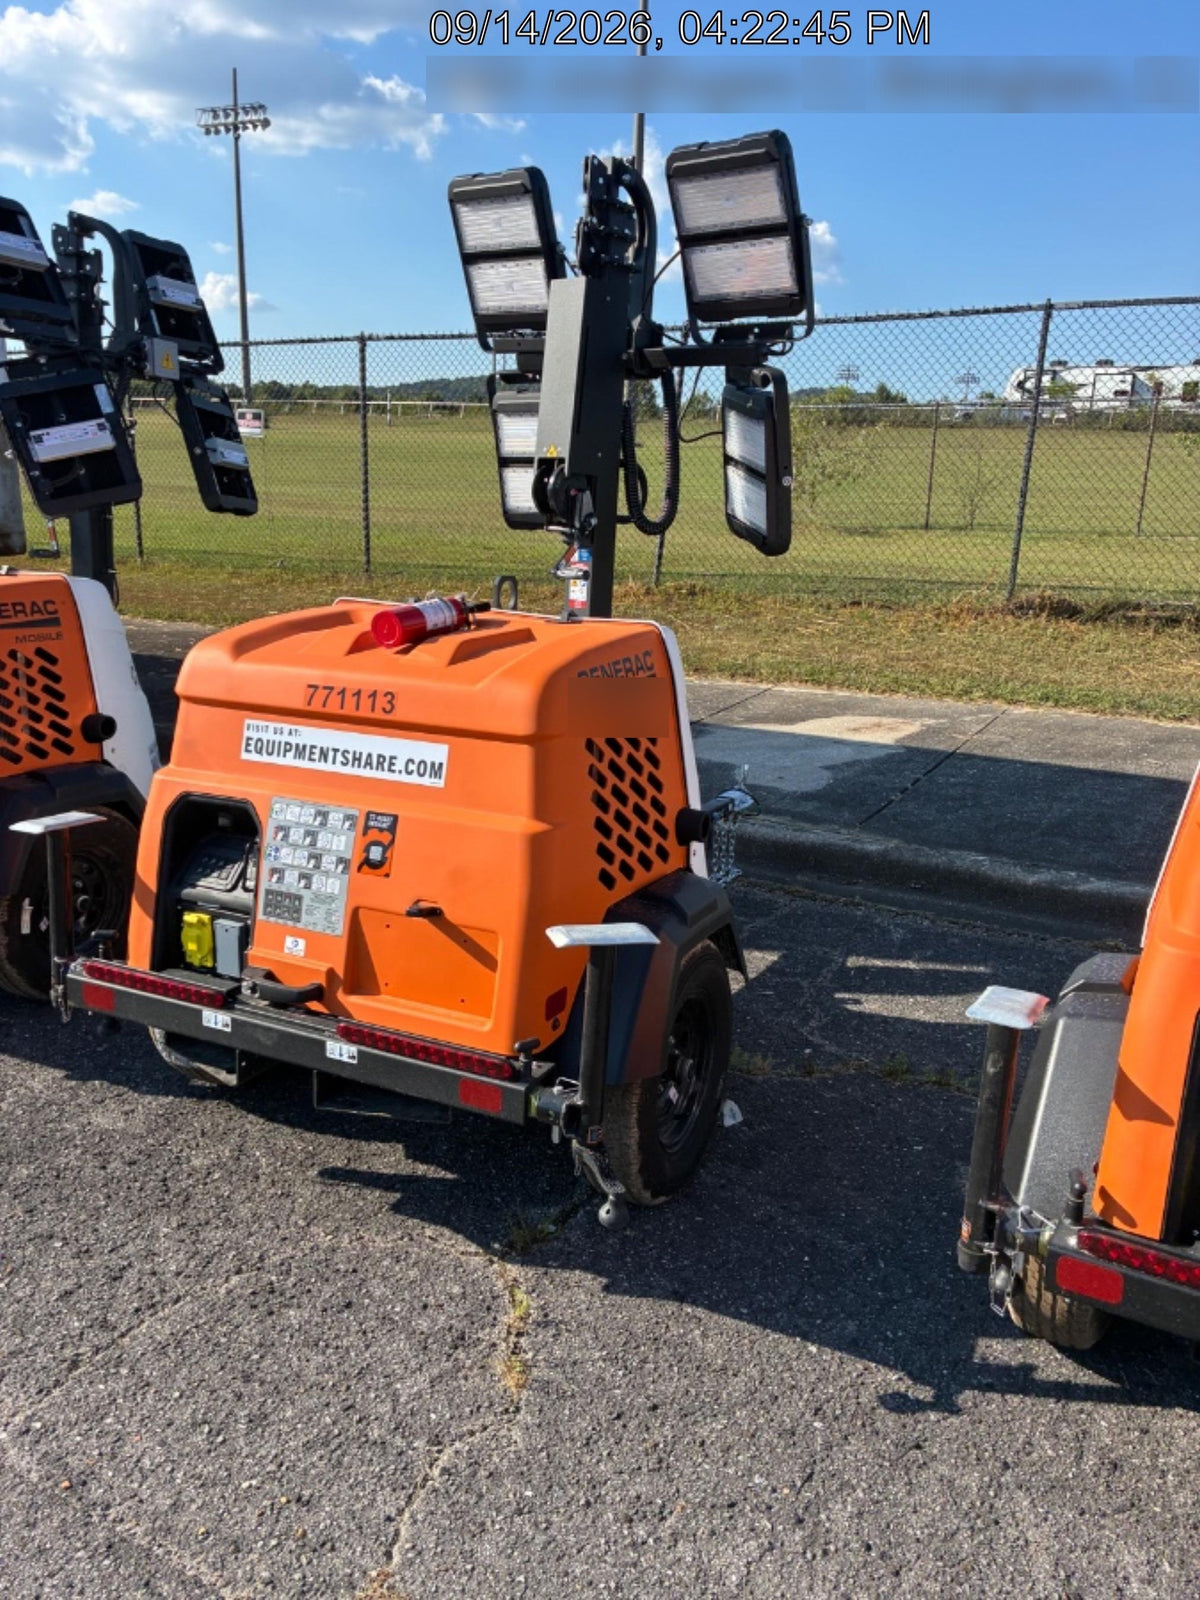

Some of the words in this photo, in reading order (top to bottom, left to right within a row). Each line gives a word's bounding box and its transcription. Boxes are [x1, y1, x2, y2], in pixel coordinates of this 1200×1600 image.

[15, 631, 63, 644] MOBILE
[306, 684, 396, 714] 771113
[246, 723, 269, 733] VISIT
[273, 726, 284, 736] US
[244, 736, 444, 779] EQUIPMENTSHARE.COM
